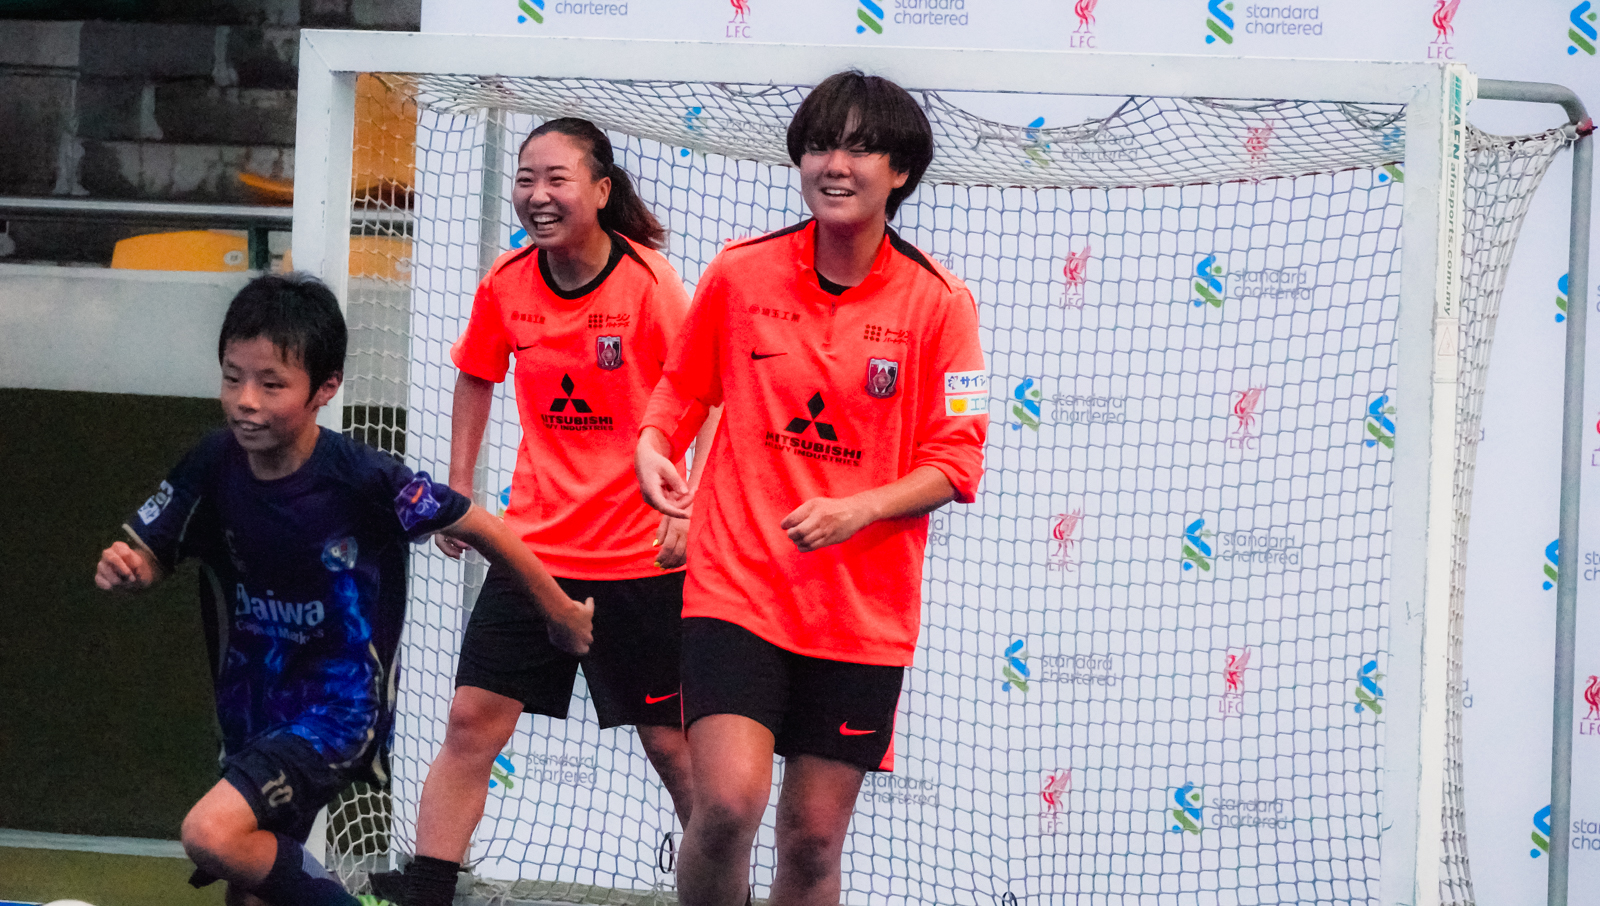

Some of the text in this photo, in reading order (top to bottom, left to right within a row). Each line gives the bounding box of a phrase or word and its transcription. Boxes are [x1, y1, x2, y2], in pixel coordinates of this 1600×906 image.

[555, 1, 628, 16] chartered
[1246, 4, 1319, 20] standard
[894, 11, 969, 26] chartered
[726, 25, 751, 38] LFC
[1245, 20, 1323, 36] chartered
[1069, 35, 1096, 48] LFC
[1427, 46, 1454, 59] LFC
[1444, 162, 1456, 316] afnsports.com.my
[1234, 267, 1307, 285] standard
[1234, 284, 1311, 301] chartered
[1052, 392, 1123, 408] standard
[1051, 407, 1126, 423] chartered
[766, 430, 861, 460] MITSUBISHI
[793, 447, 860, 467] INDUSTRIES
[1223, 533, 1296, 548] standard
[1223, 548, 1299, 566] chartered
[1584, 550, 1600, 566] st
[235, 583, 325, 627] Daiwa
[1042, 653, 1113, 671] standard
[1042, 669, 1117, 687] chartered
[1218, 699, 1244, 714] LFC
[527, 751, 594, 768] standard
[527, 766, 598, 784] chartered
[863, 773, 934, 791] standard
[1212, 796, 1283, 814] standard
[1211, 812, 1288, 830] chartered
[1572, 818, 1600, 835] sta
